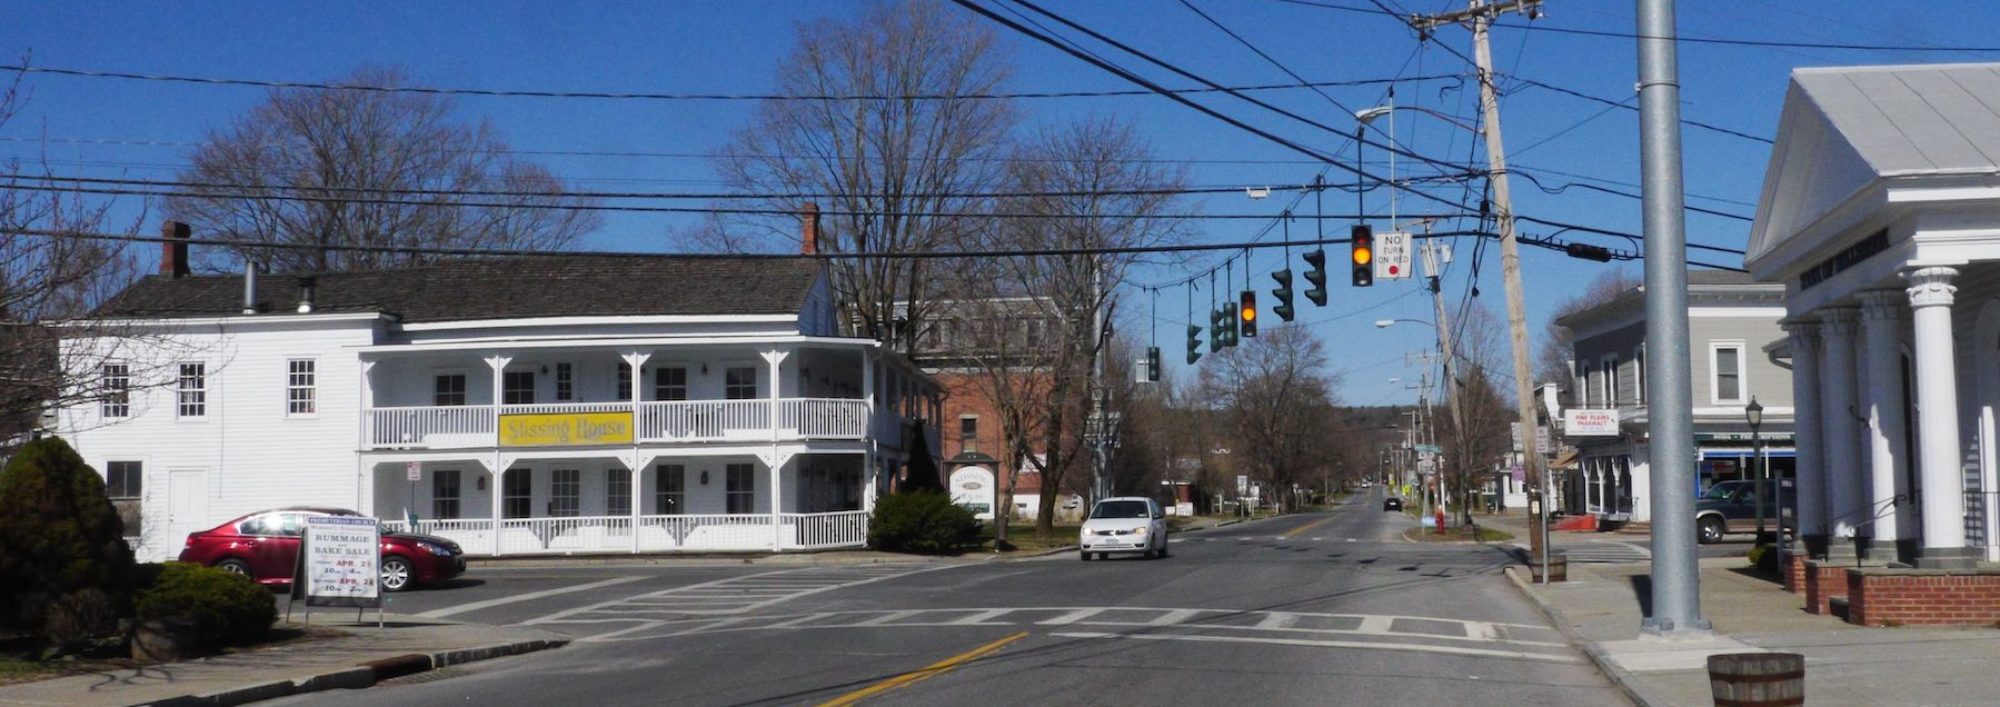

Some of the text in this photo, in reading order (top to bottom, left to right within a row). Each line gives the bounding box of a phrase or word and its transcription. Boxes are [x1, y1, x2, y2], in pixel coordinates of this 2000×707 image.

[1385, 236, 1402, 244] NO
[1383, 247, 1404, 255] TURN
[1378, 256, 1409, 264] ON RED
[576, 418, 626, 440] House
[315, 534, 370, 543] RUMMAGE
[315, 547, 370, 556] BAKE SALE
